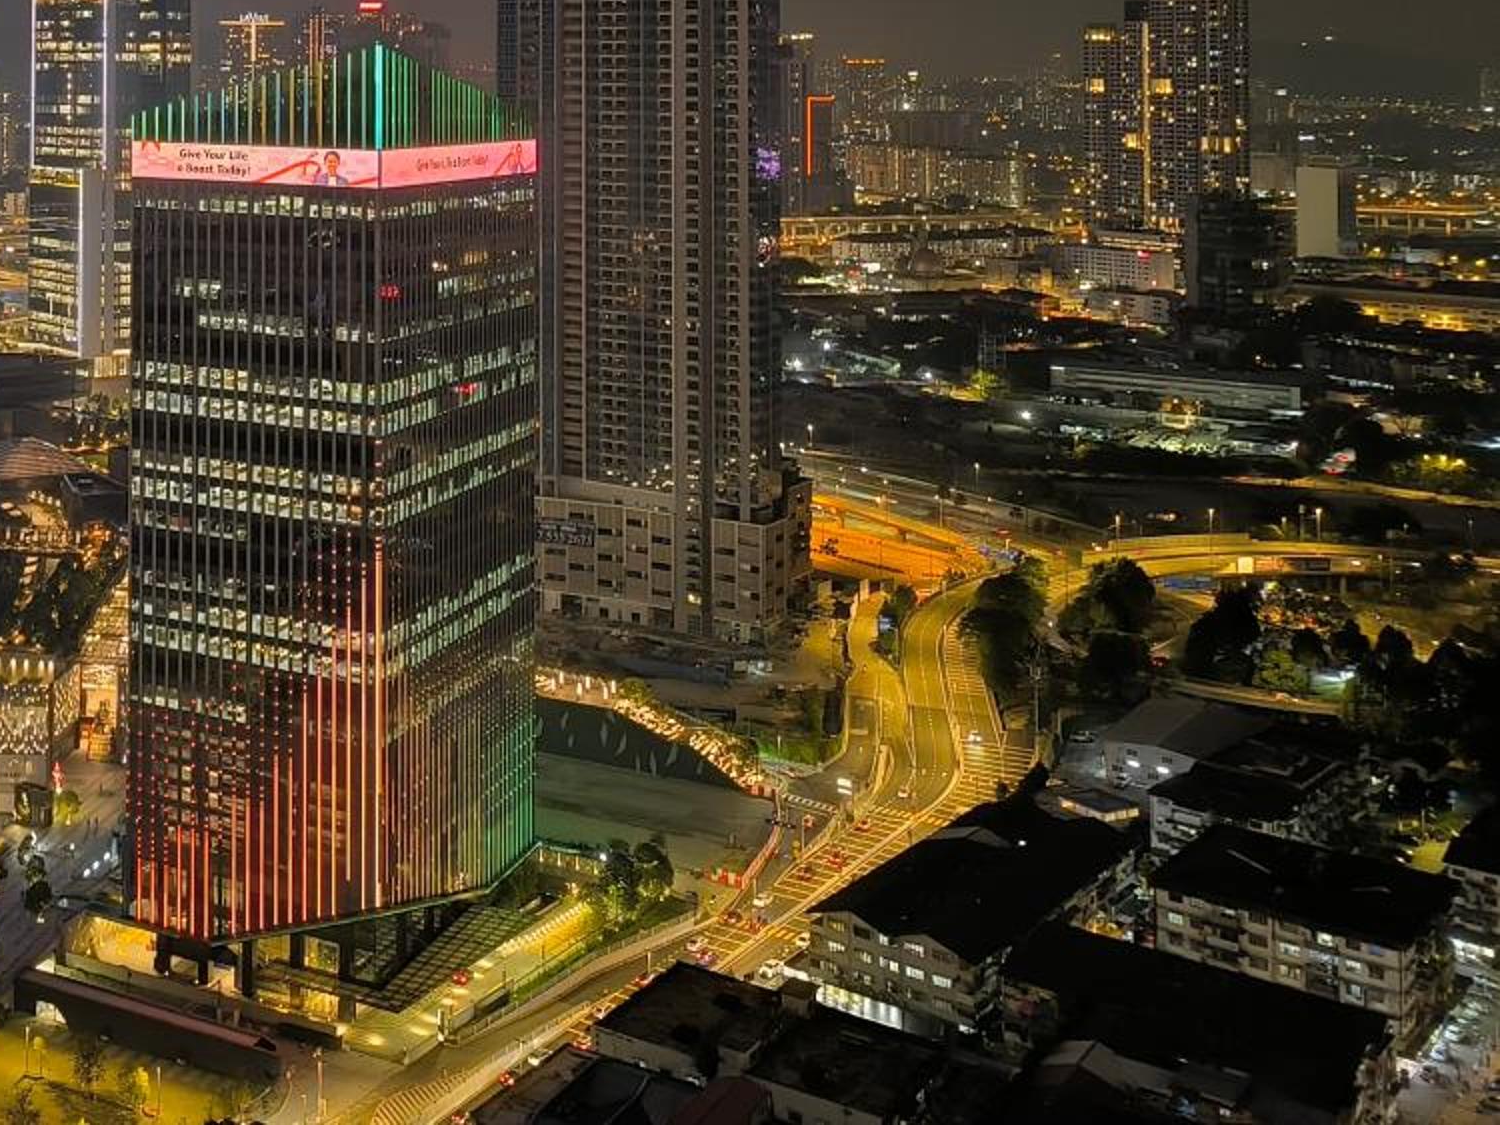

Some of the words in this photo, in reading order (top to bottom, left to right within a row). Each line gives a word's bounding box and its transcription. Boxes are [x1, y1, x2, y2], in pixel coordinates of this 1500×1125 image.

[180, 148, 201, 160] Give
[204, 149, 226, 160] Your
[229, 150, 249, 161] Life
